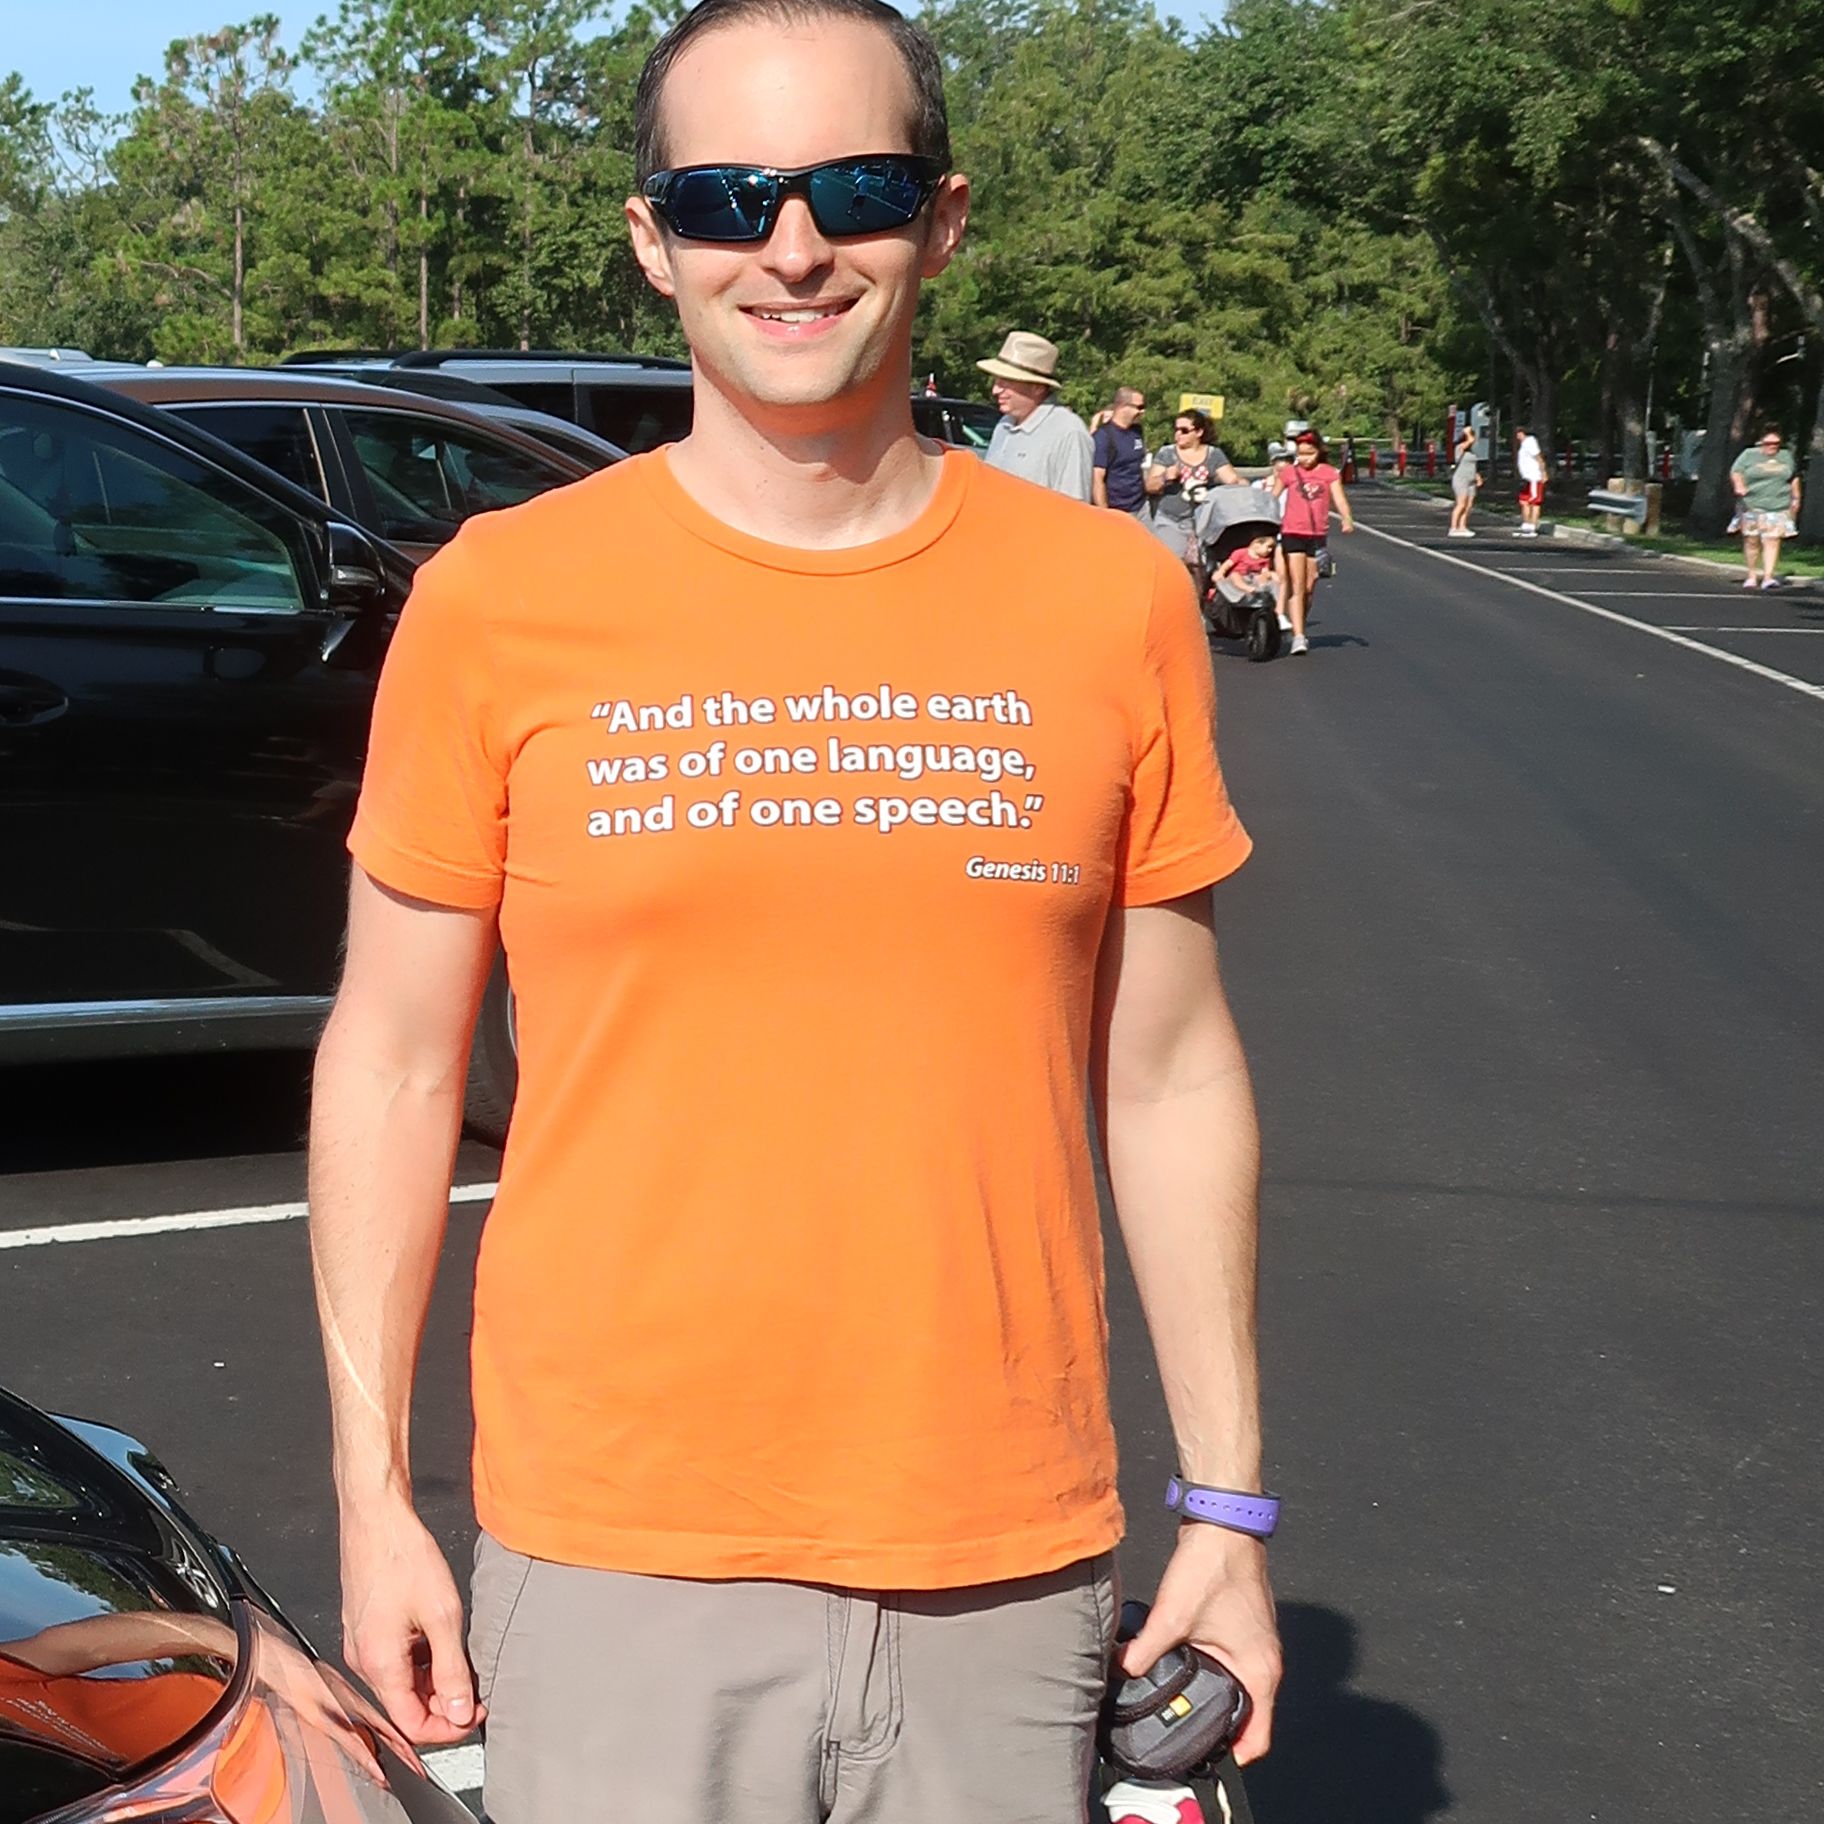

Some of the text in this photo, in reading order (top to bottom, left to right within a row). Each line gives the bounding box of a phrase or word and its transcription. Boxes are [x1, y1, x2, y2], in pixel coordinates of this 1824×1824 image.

[590, 684, 1031, 734] “And the whole earth
[587, 737, 1035, 785] was of one language,
[587, 790, 1044, 837] and of one speech.”
[965, 856, 1081, 885] Genesis 11:1
